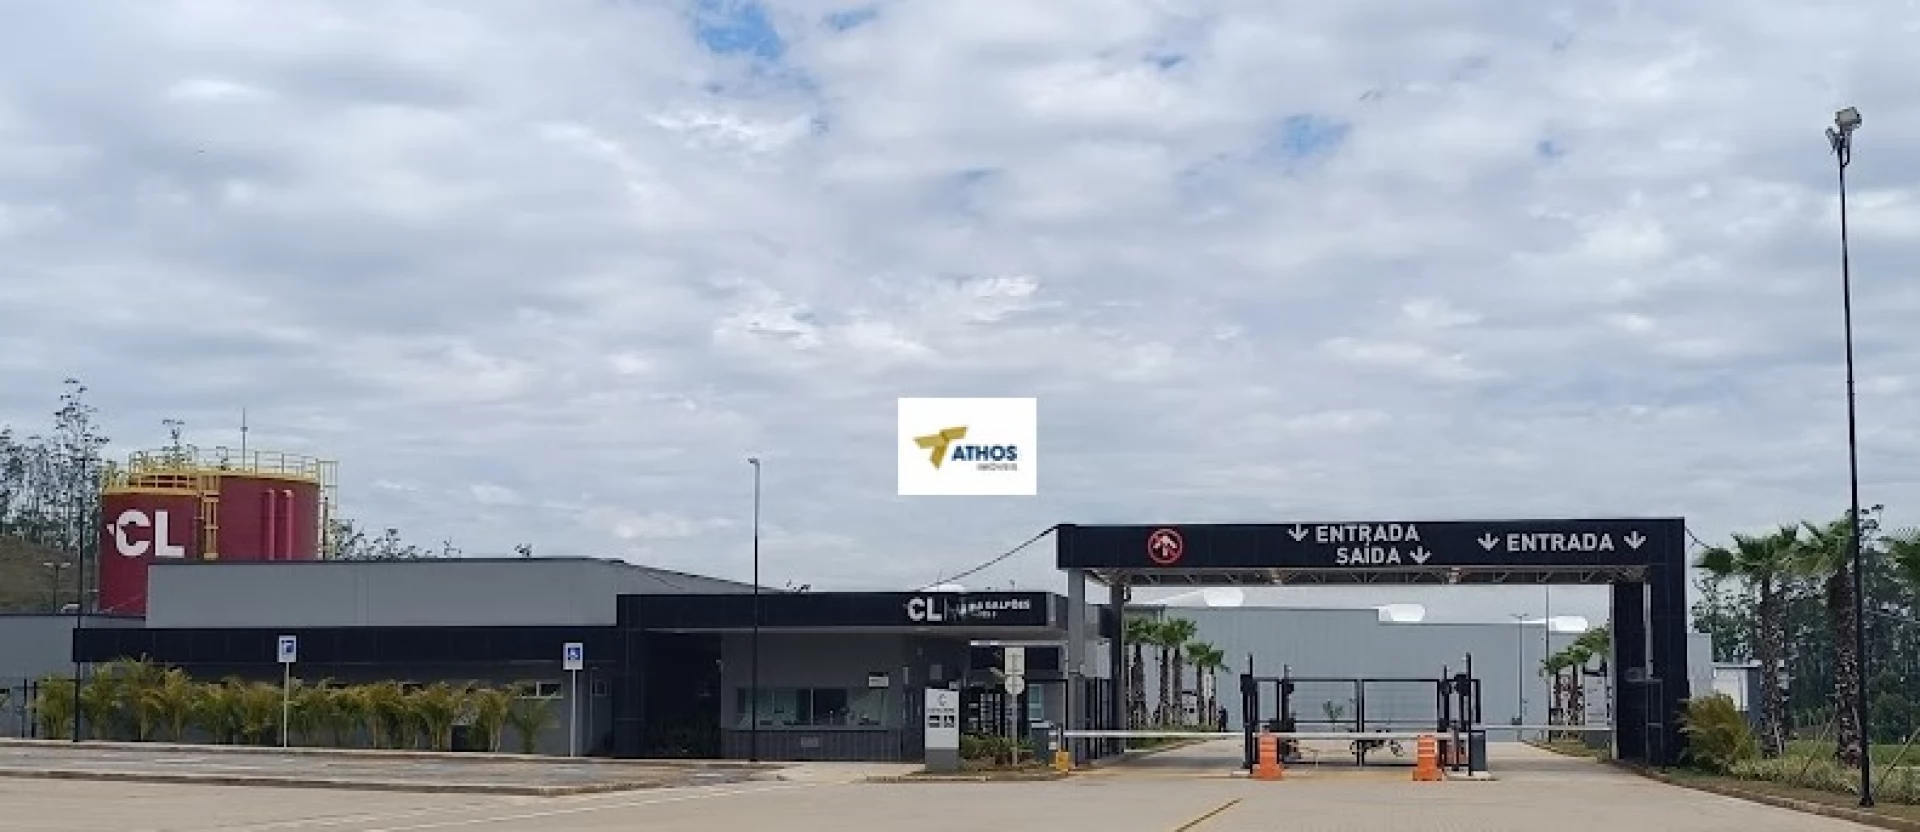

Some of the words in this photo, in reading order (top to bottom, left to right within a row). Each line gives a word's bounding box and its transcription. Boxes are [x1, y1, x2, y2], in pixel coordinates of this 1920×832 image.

[116, 509, 185, 558] CL
[1316, 523, 1421, 543] ENTRADA
[1506, 533, 1615, 551] ENTRADA
[1336, 540, 1401, 564] SAÍDA
[908, 597, 942, 621] CL
